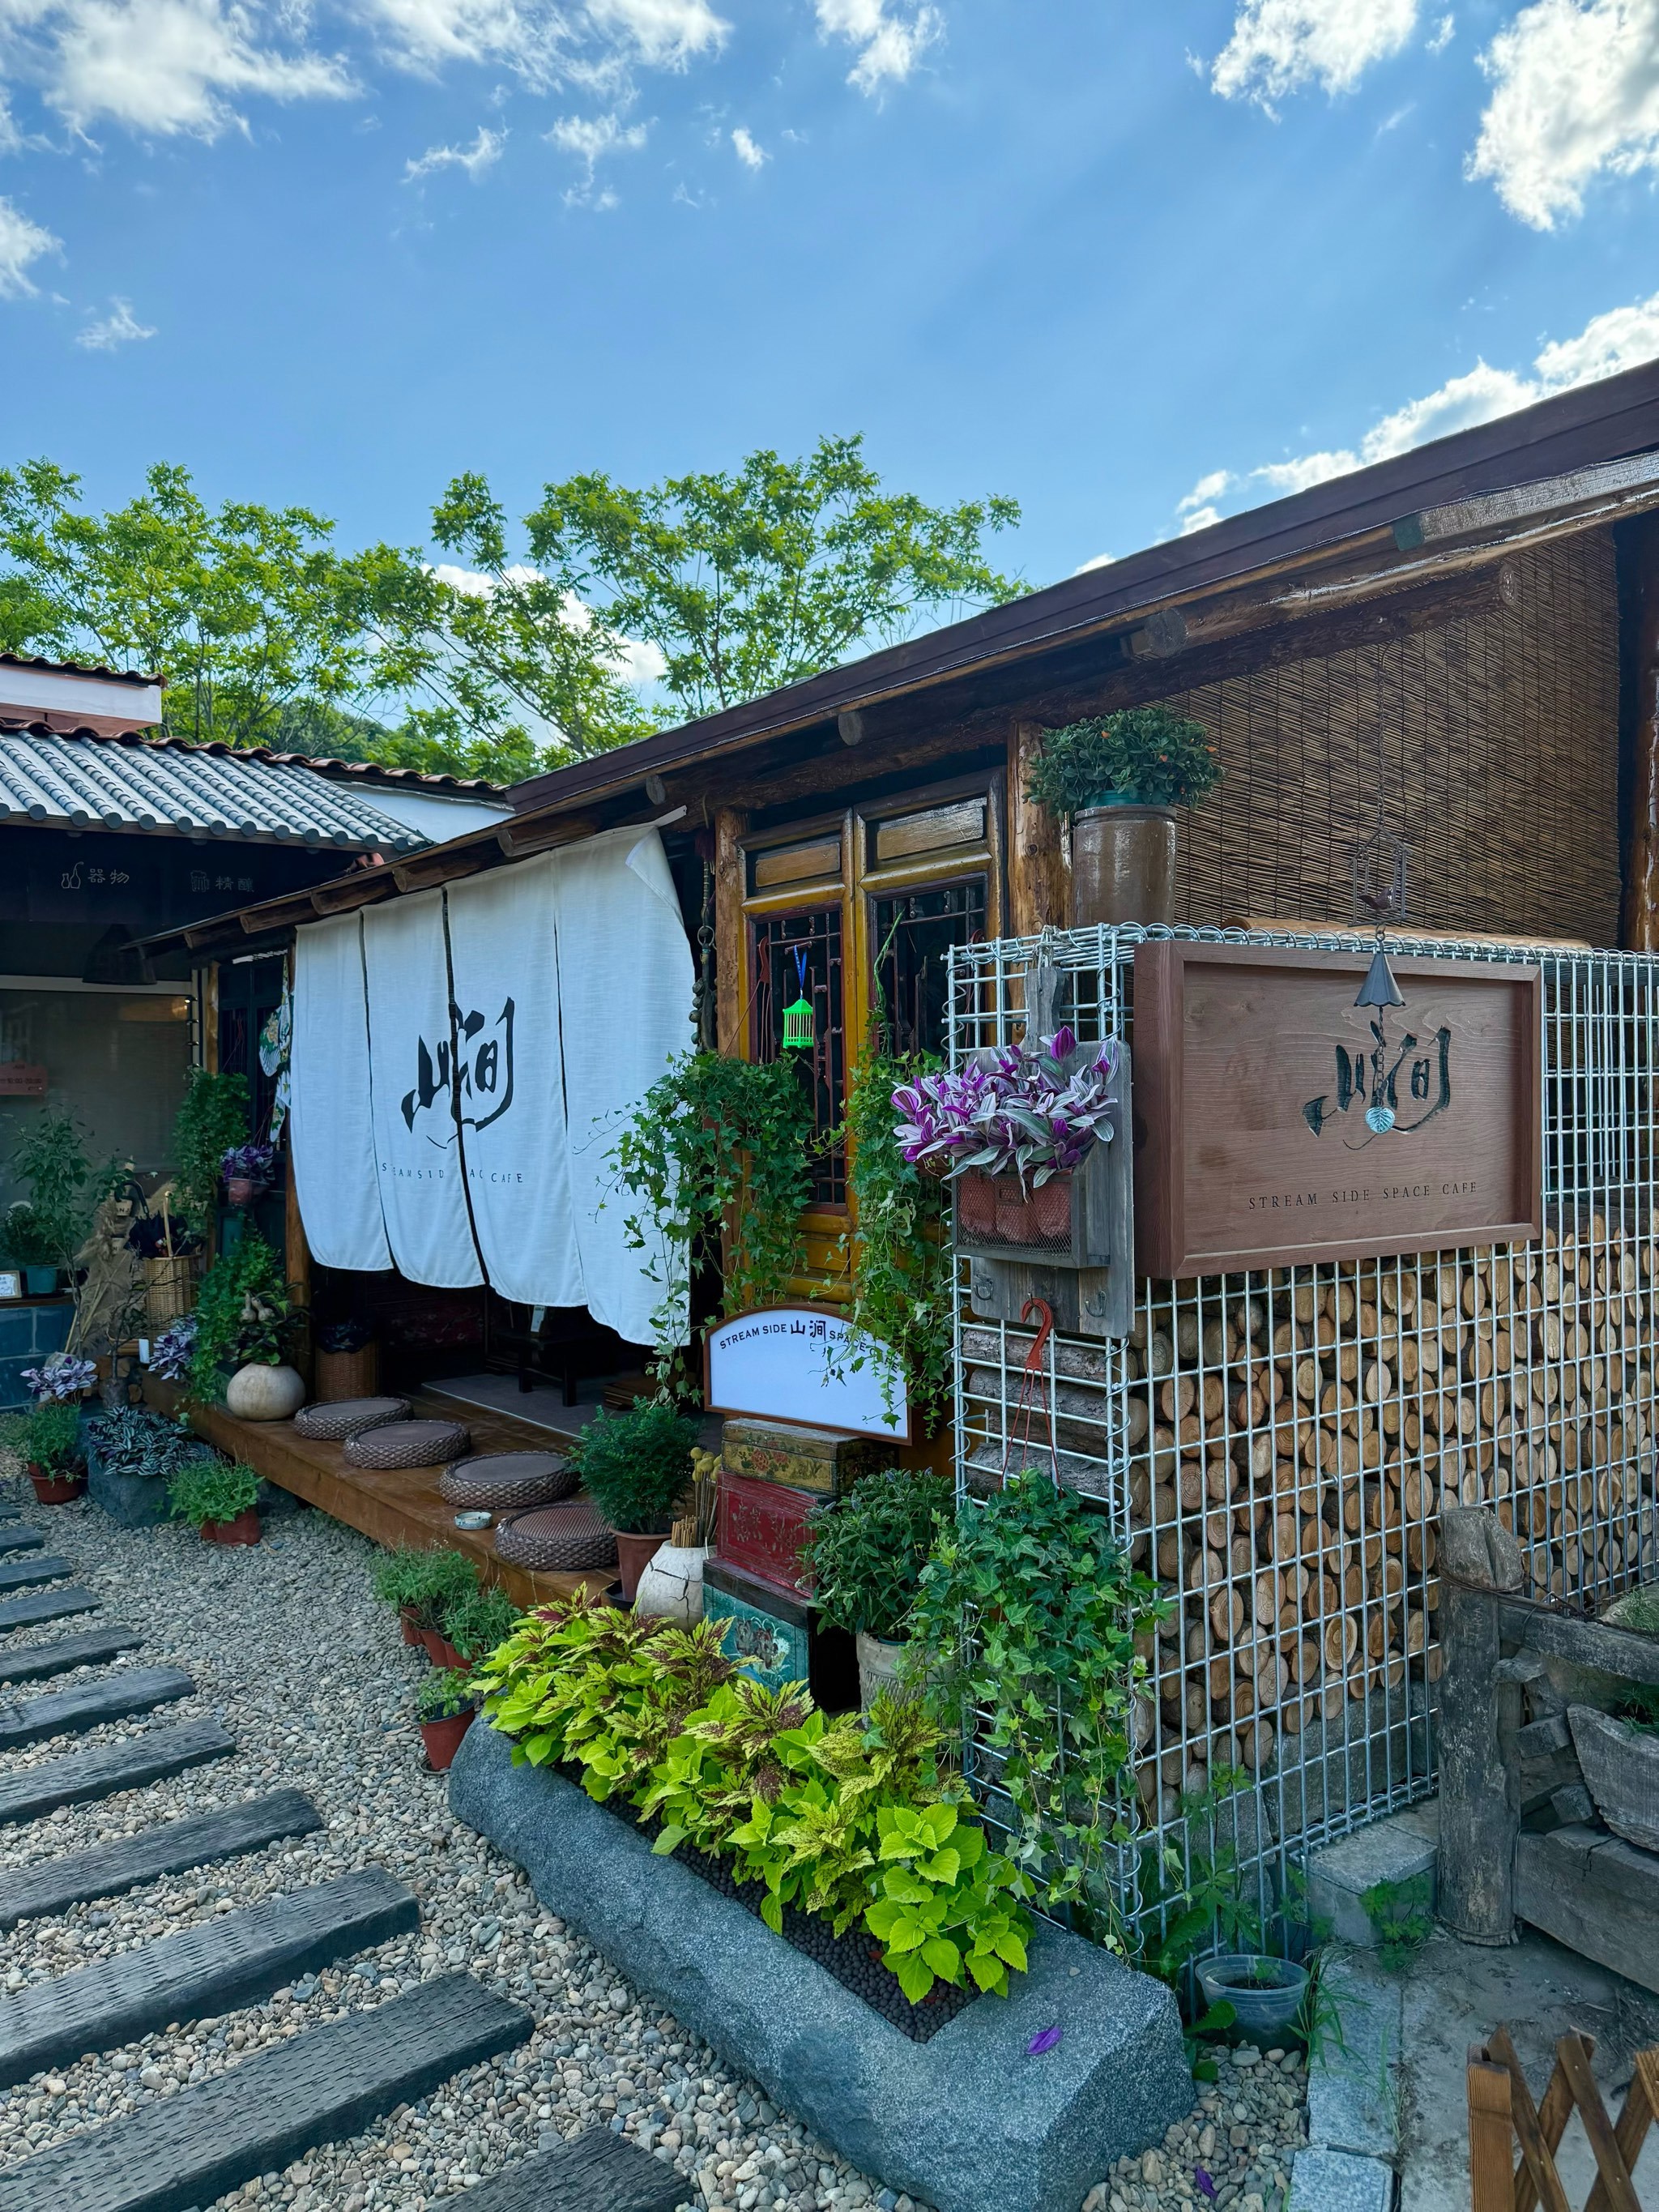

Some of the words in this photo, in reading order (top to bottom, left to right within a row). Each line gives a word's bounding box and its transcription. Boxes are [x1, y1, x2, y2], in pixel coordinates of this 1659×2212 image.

[87, 868, 130, 885] 器物
[1248, 1193, 1319, 1210] STREAM
[1332, 1189, 1370, 1203] SIDE
[1383, 1185, 1431, 1199] SPACE
[1442, 1181, 1478, 1196] CAFE
[719, 1327, 760, 1349] STREAM
[762, 1323, 787, 1334] SIDE
[791, 1320, 826, 1343] 山涧
